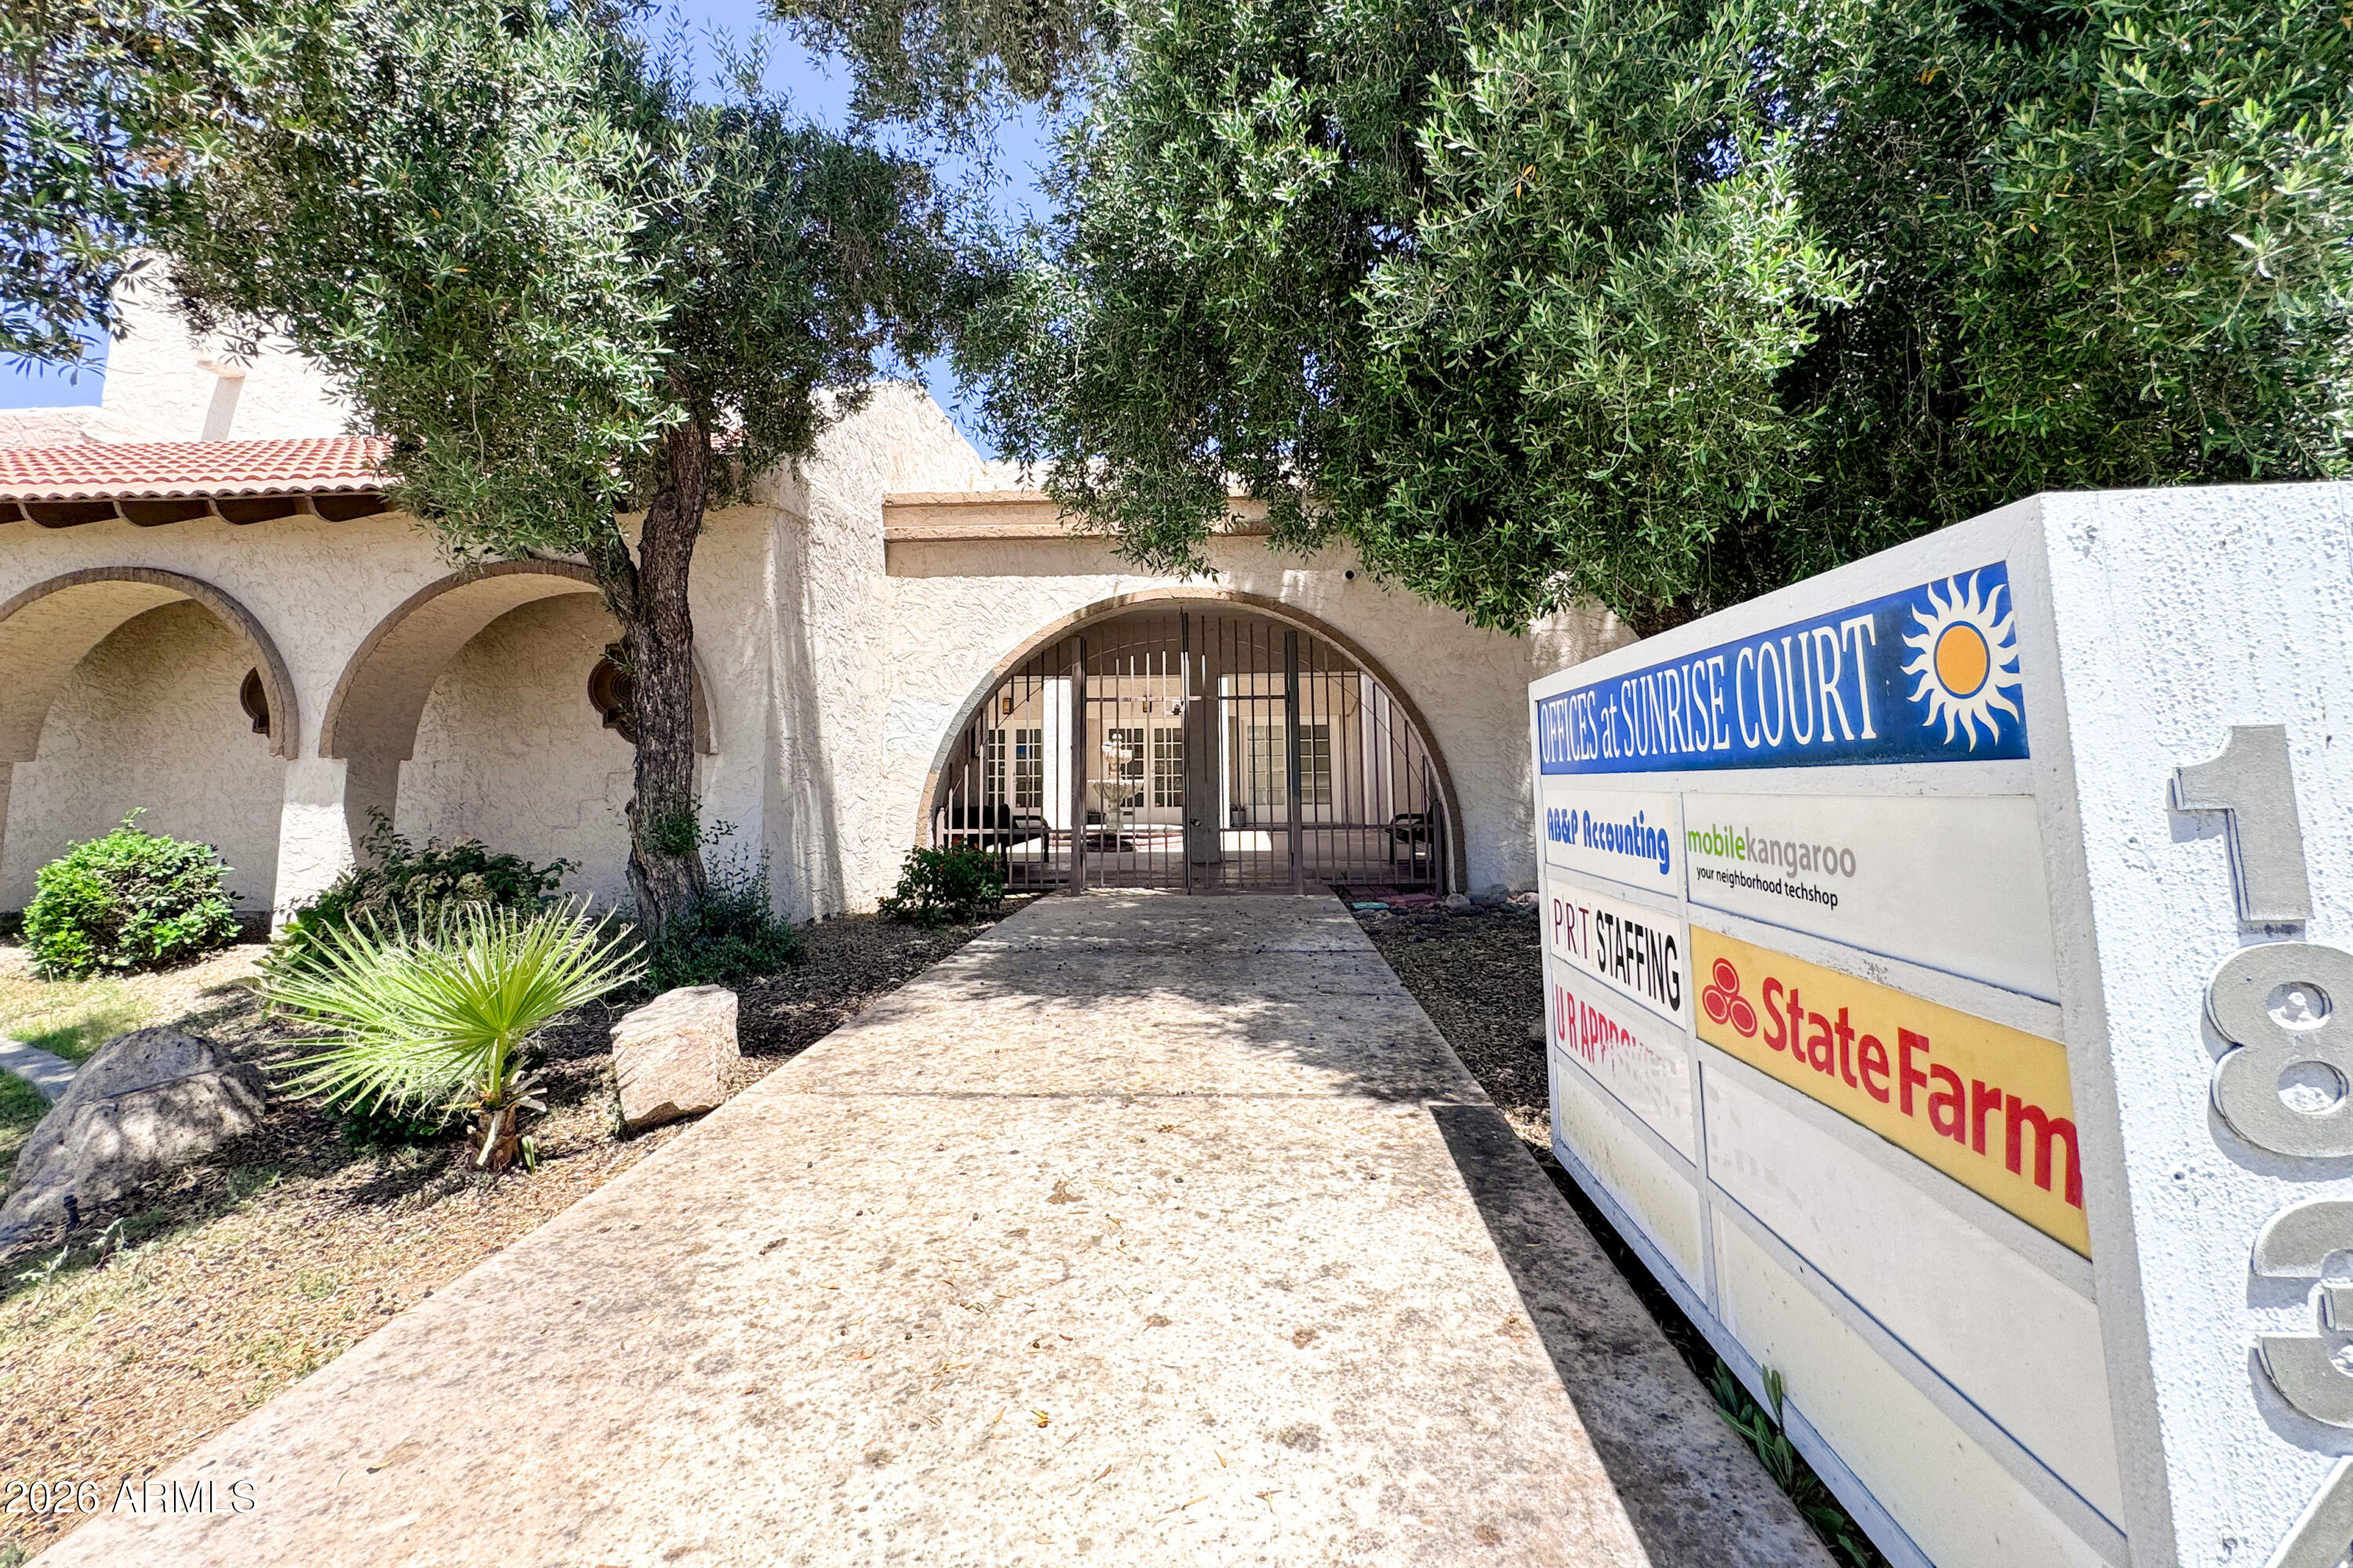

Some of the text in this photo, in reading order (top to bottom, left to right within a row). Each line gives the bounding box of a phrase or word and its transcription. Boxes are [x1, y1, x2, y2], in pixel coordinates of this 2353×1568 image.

[1540, 613, 1877, 764] OFFICES at SUNRISE COURT
[1547, 807, 1670, 875] AB&P Accounting
[1697, 866, 1838, 911] your neighborhood techshop
[1596, 909, 1681, 1012] STAFFING
